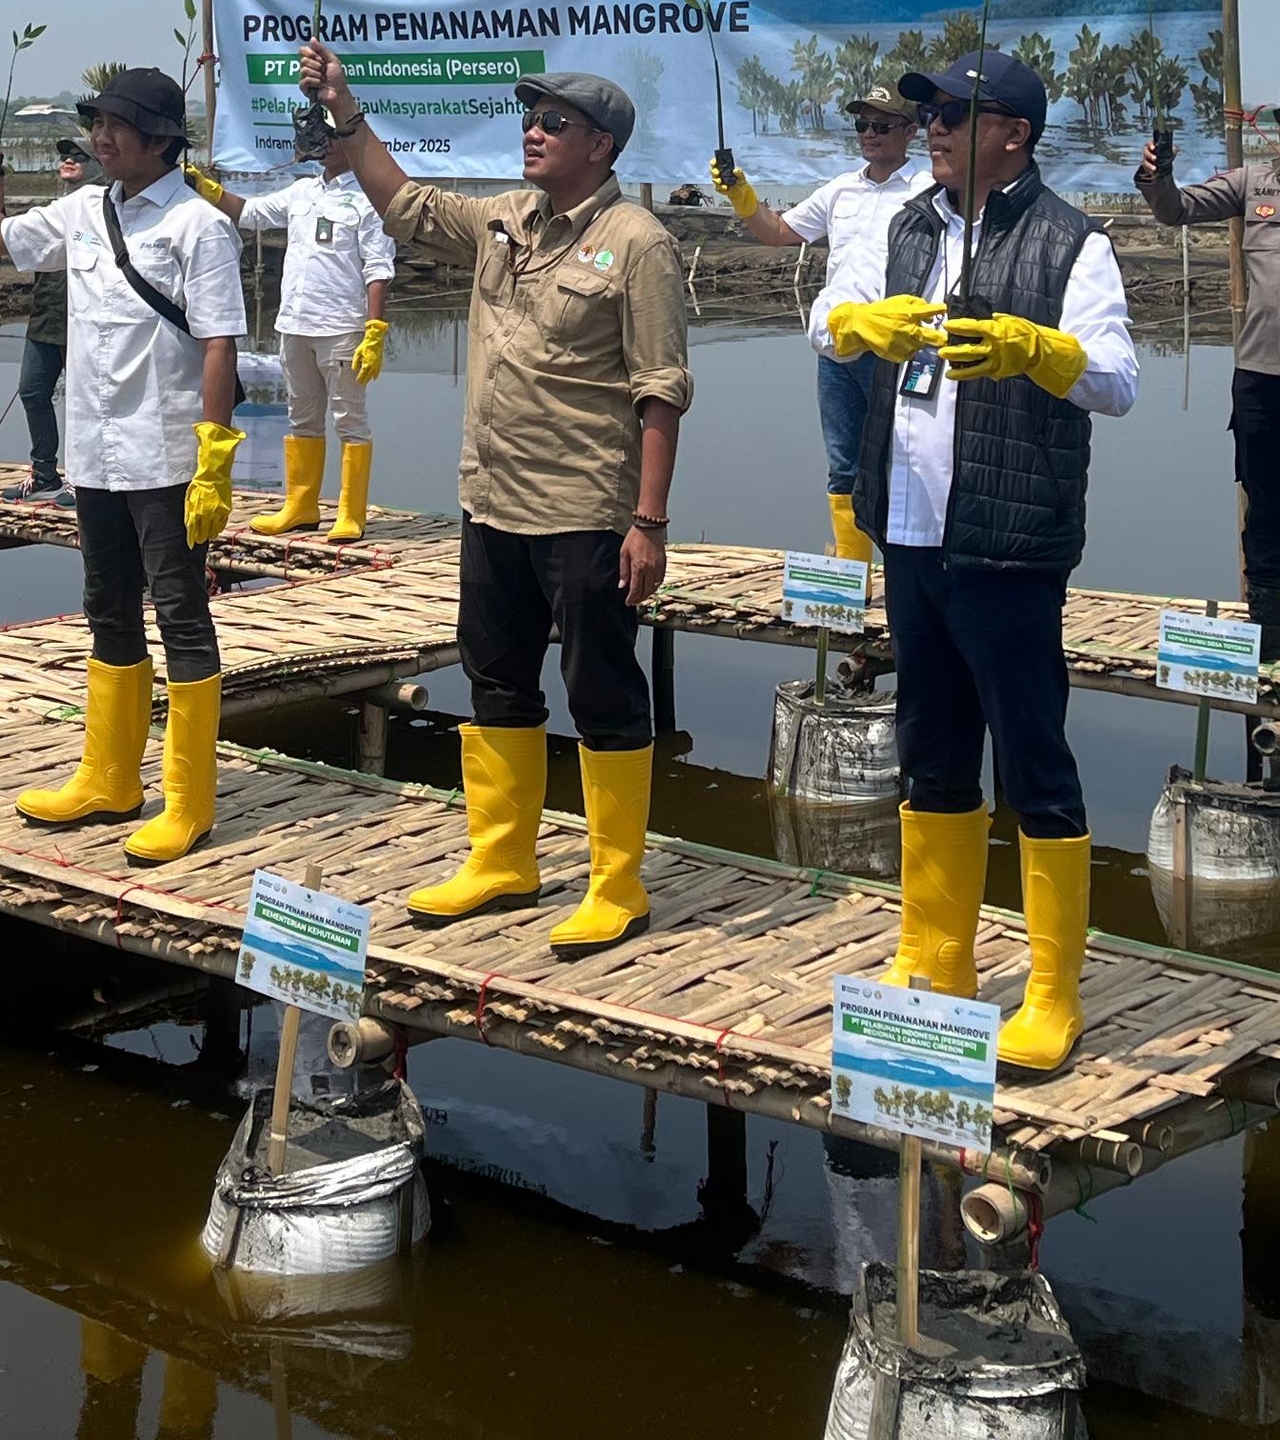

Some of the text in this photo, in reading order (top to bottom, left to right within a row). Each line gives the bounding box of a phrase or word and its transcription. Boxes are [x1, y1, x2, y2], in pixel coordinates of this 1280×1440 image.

[243, 1, 750, 42] PROGRAM PENANAMAN MANGROVE
[264, 60, 285, 76] PT
[368, 59, 442, 77] Indonesia
[446, 57, 520, 80] (Persero)
[418, 138, 451, 153] 2025
[255, 892, 362, 937] PROGRAM PENANAMAN MANGROVE
[262, 908, 306, 932] KEMENTERIAN
[308, 925, 352, 947] KEHUTANAN
[840, 1002, 990, 1041] PROGRAM PENANAMAN MANGROVE
[851, 1018, 860, 1026] PT
[861, 1019, 901, 1035] PELABUHAN
[901, 1027, 940, 1043] INDONESIA
[863, 1027, 896, 1042] REGIONAL
[902, 1036, 931, 1050] CABANG
[932, 1042, 964, 1056] CIREBON
